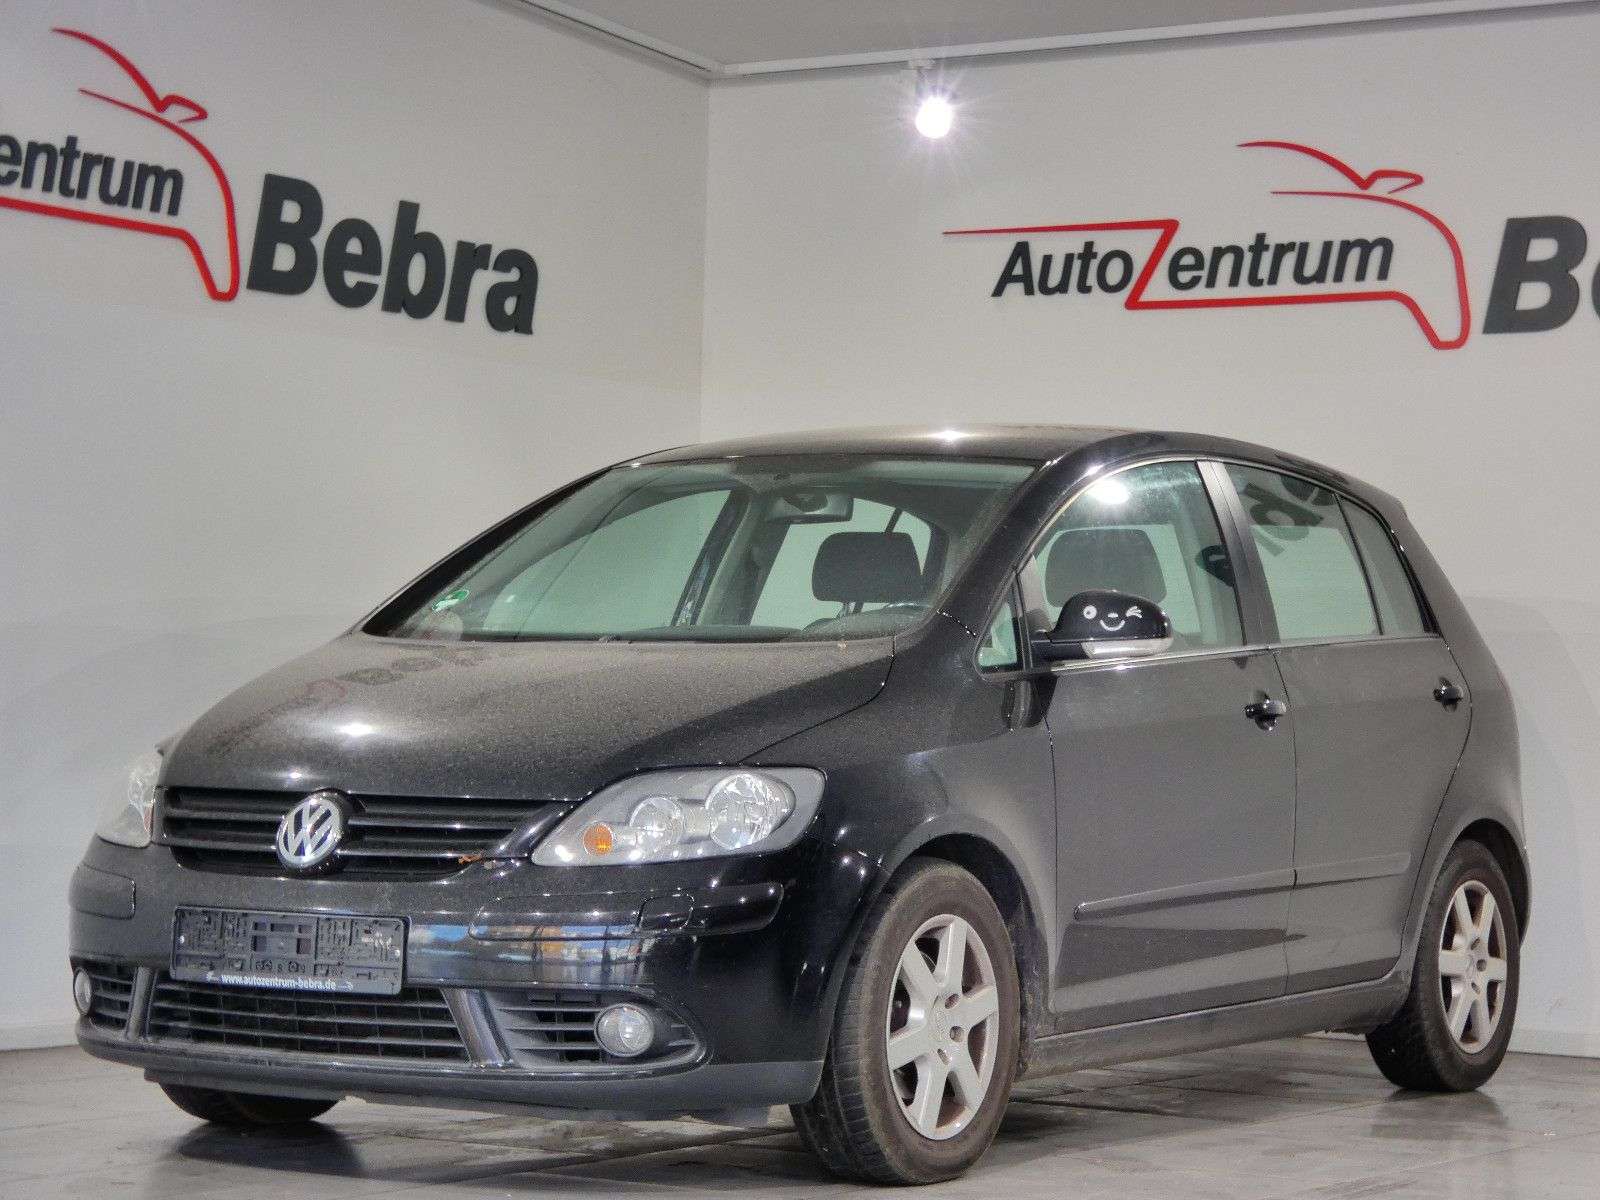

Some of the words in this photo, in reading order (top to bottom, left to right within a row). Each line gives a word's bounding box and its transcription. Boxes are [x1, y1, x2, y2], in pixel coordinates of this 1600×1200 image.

[246, 173, 538, 335] Bebra
[990, 218, 1394, 308] AutoZentrum
[1482, 215, 1600, 334] B
[278, 797, 341, 865] VW
[221, 974, 337, 991] www.autozentrum-bebra.de
